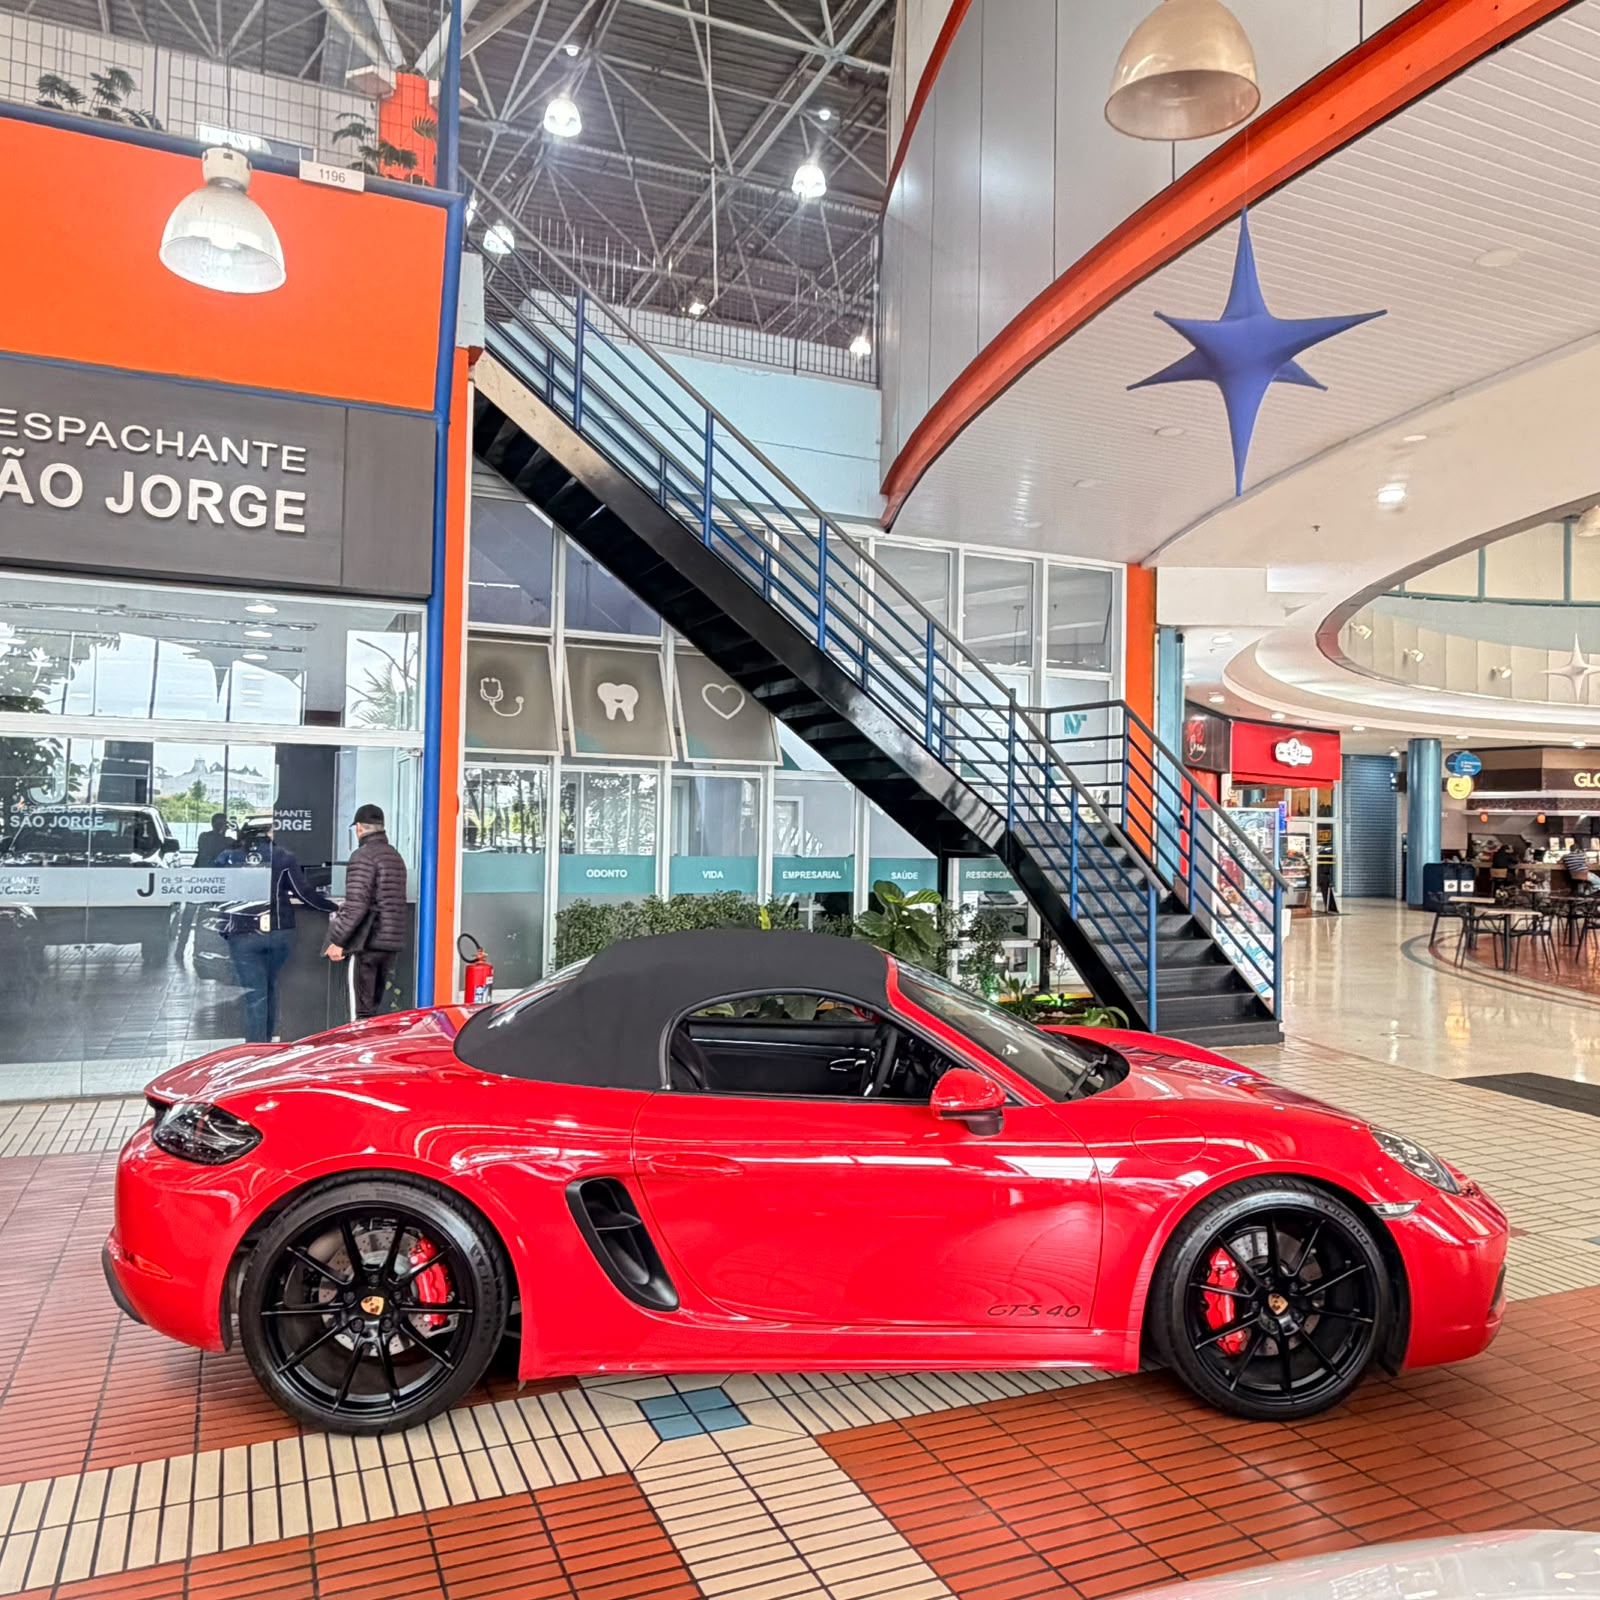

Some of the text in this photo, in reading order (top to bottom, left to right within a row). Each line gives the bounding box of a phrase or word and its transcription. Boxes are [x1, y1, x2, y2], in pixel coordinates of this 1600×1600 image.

[319, 168, 346, 184] 1196
[0, 408, 306, 473] ESPACHANTE
[0, 446, 306, 533] ÃO JORGE
[49, 816, 104, 828] JORGE
[586, 869, 628, 878] ODONTO
[702, 870, 724, 879] VIDA
[782, 871, 841, 879] EMPRESARIAL
[891, 871, 919, 880] SAÚDE
[966, 871, 1013, 879] RESIDENCIA
[137, 872, 155, 897] J
[187, 886, 226, 894] JORGE
[987, 1304, 1043, 1317] GTS
